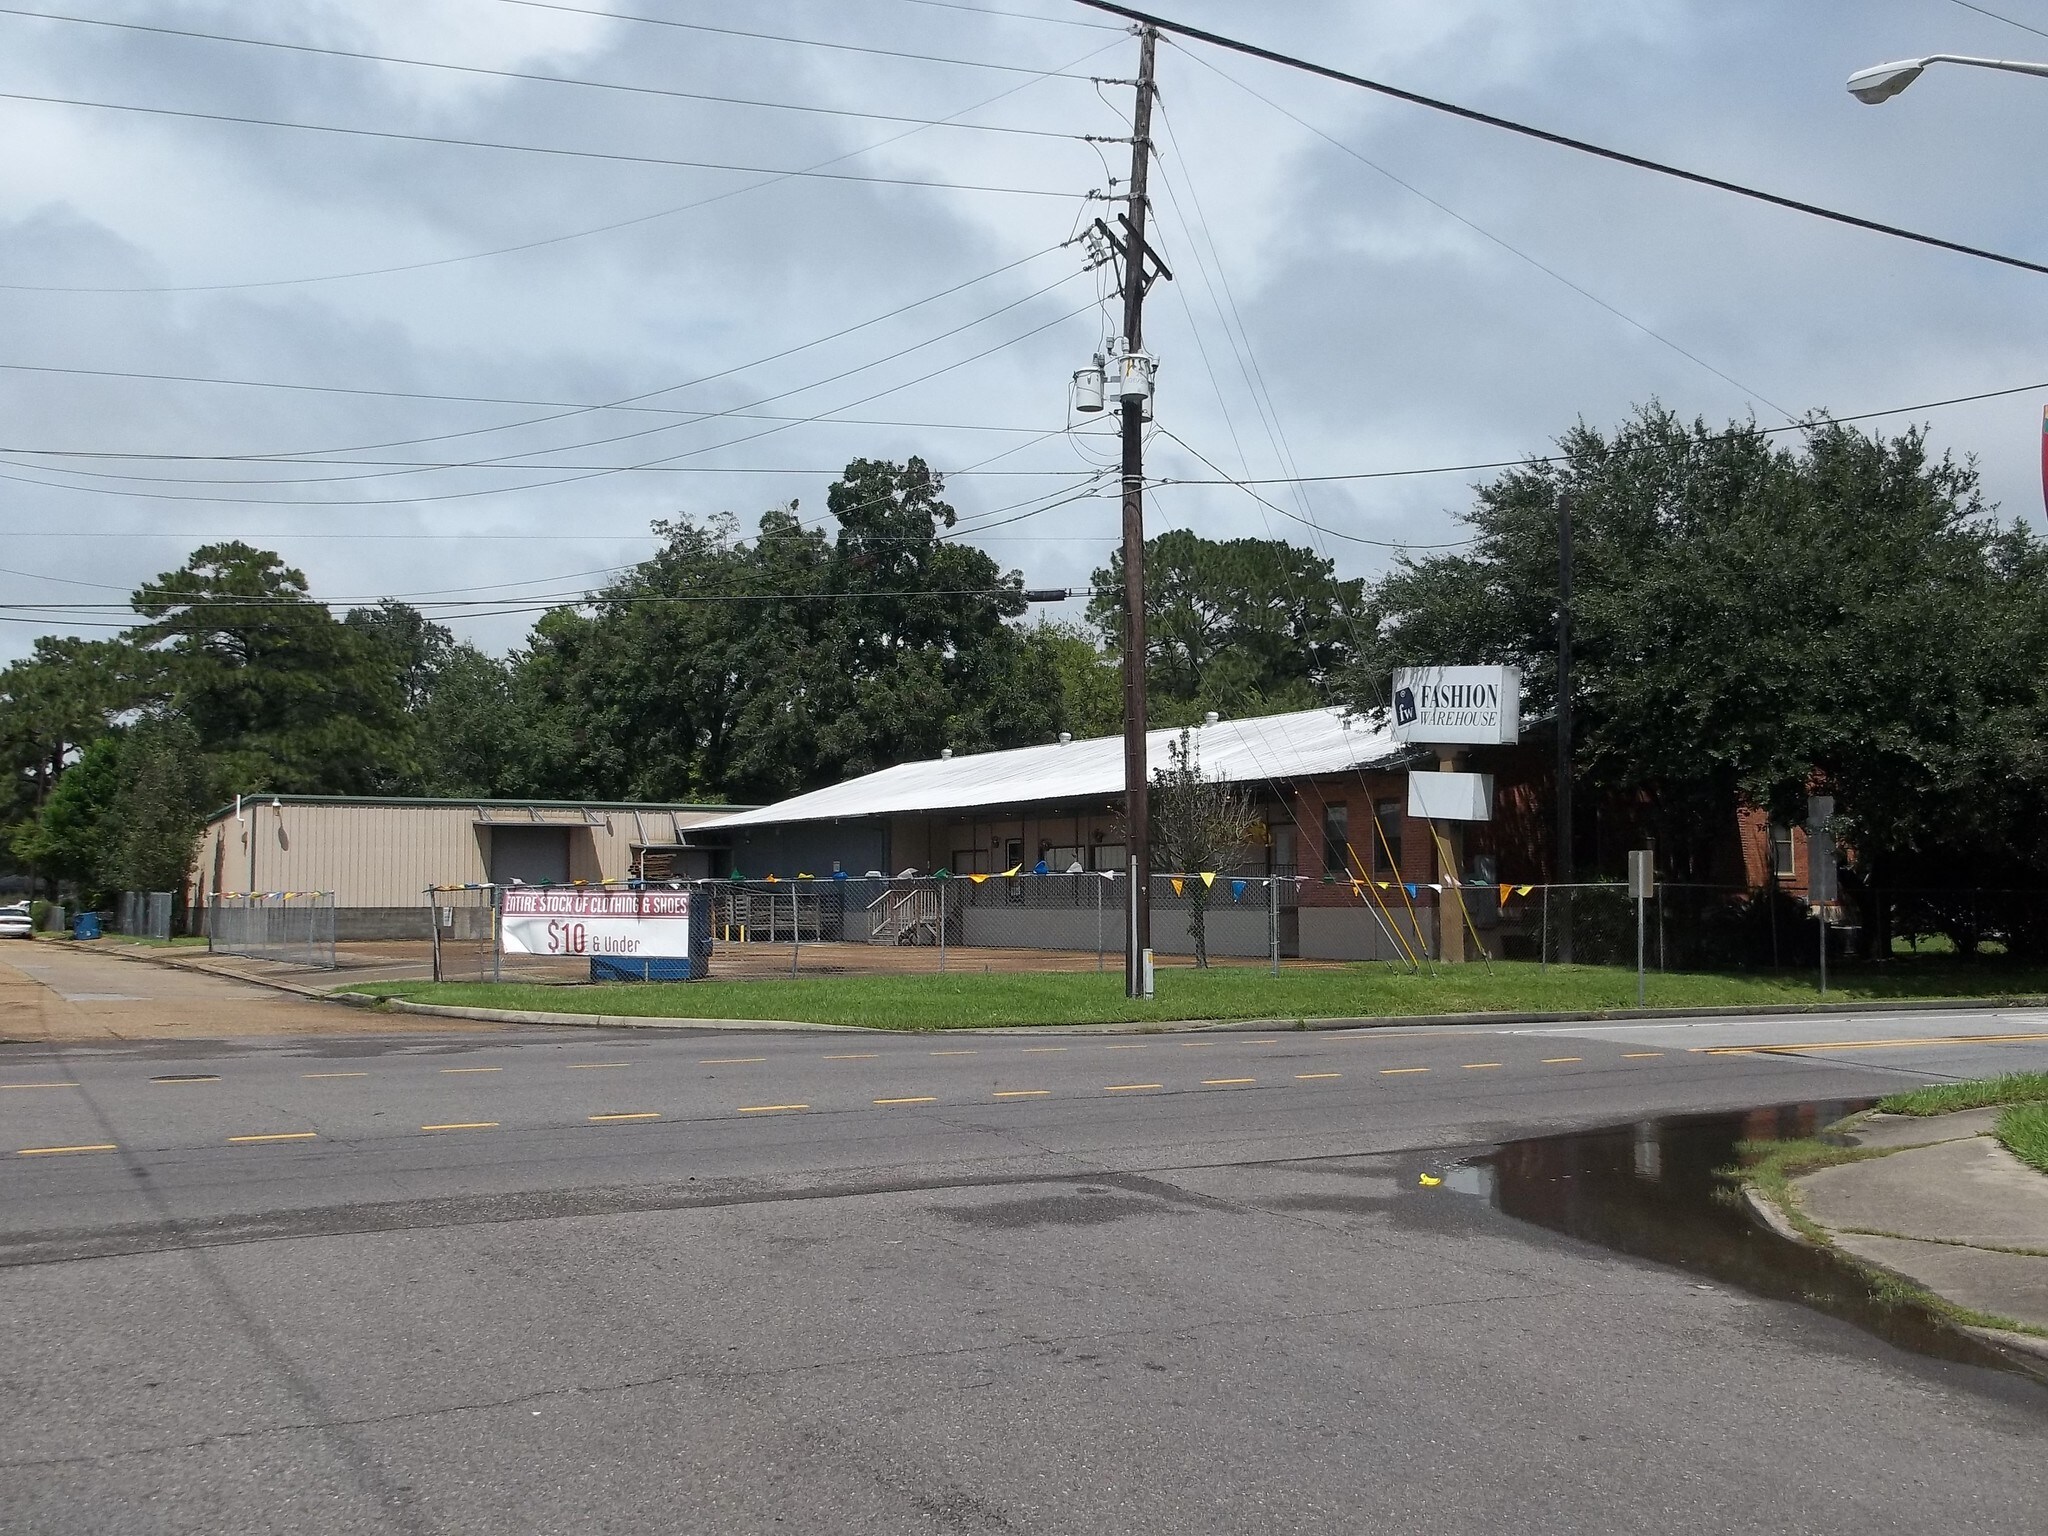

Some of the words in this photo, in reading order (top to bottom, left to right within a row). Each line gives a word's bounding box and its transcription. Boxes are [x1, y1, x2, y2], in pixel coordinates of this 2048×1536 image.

[1421, 684, 1499, 709] FASHION
[1399, 703, 1414, 722] fw
[1420, 711, 1498, 727] WAREHOUSE
[505, 896, 537, 912] ENTIRE
[539, 896, 573, 913] STOCK
[575, 896, 589, 912] OF
[590, 896, 639, 913] CLOTHING
[642, 897, 651, 912] &
[653, 898, 688, 914] SHOES
[547, 919, 585, 954] $10
[592, 937, 601, 952] &
[604, 936, 641, 953] Under
